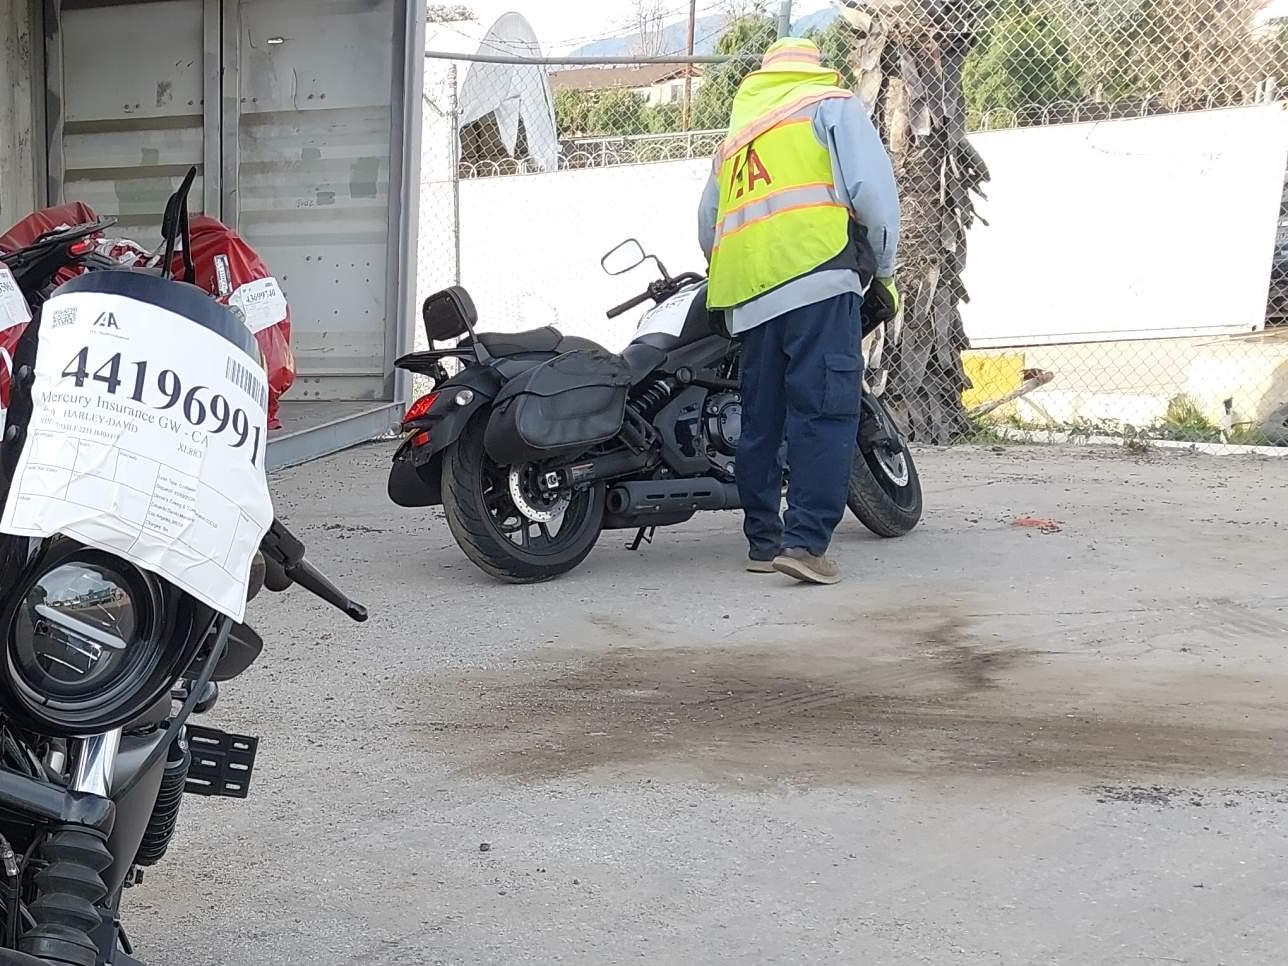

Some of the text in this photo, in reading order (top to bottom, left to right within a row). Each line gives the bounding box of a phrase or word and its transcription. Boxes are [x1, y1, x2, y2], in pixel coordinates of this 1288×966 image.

[42, 391, 92, 408] Mercury
[96, 395, 155, 424] Insurance
[158, 416, 182, 433] GW
[191, 430, 209, 448] CA
[62, 346, 261, 469] 44196991
[63, 409, 139, 433] HARLEY-DAVID
[178, 442, 202, 458] XL883
